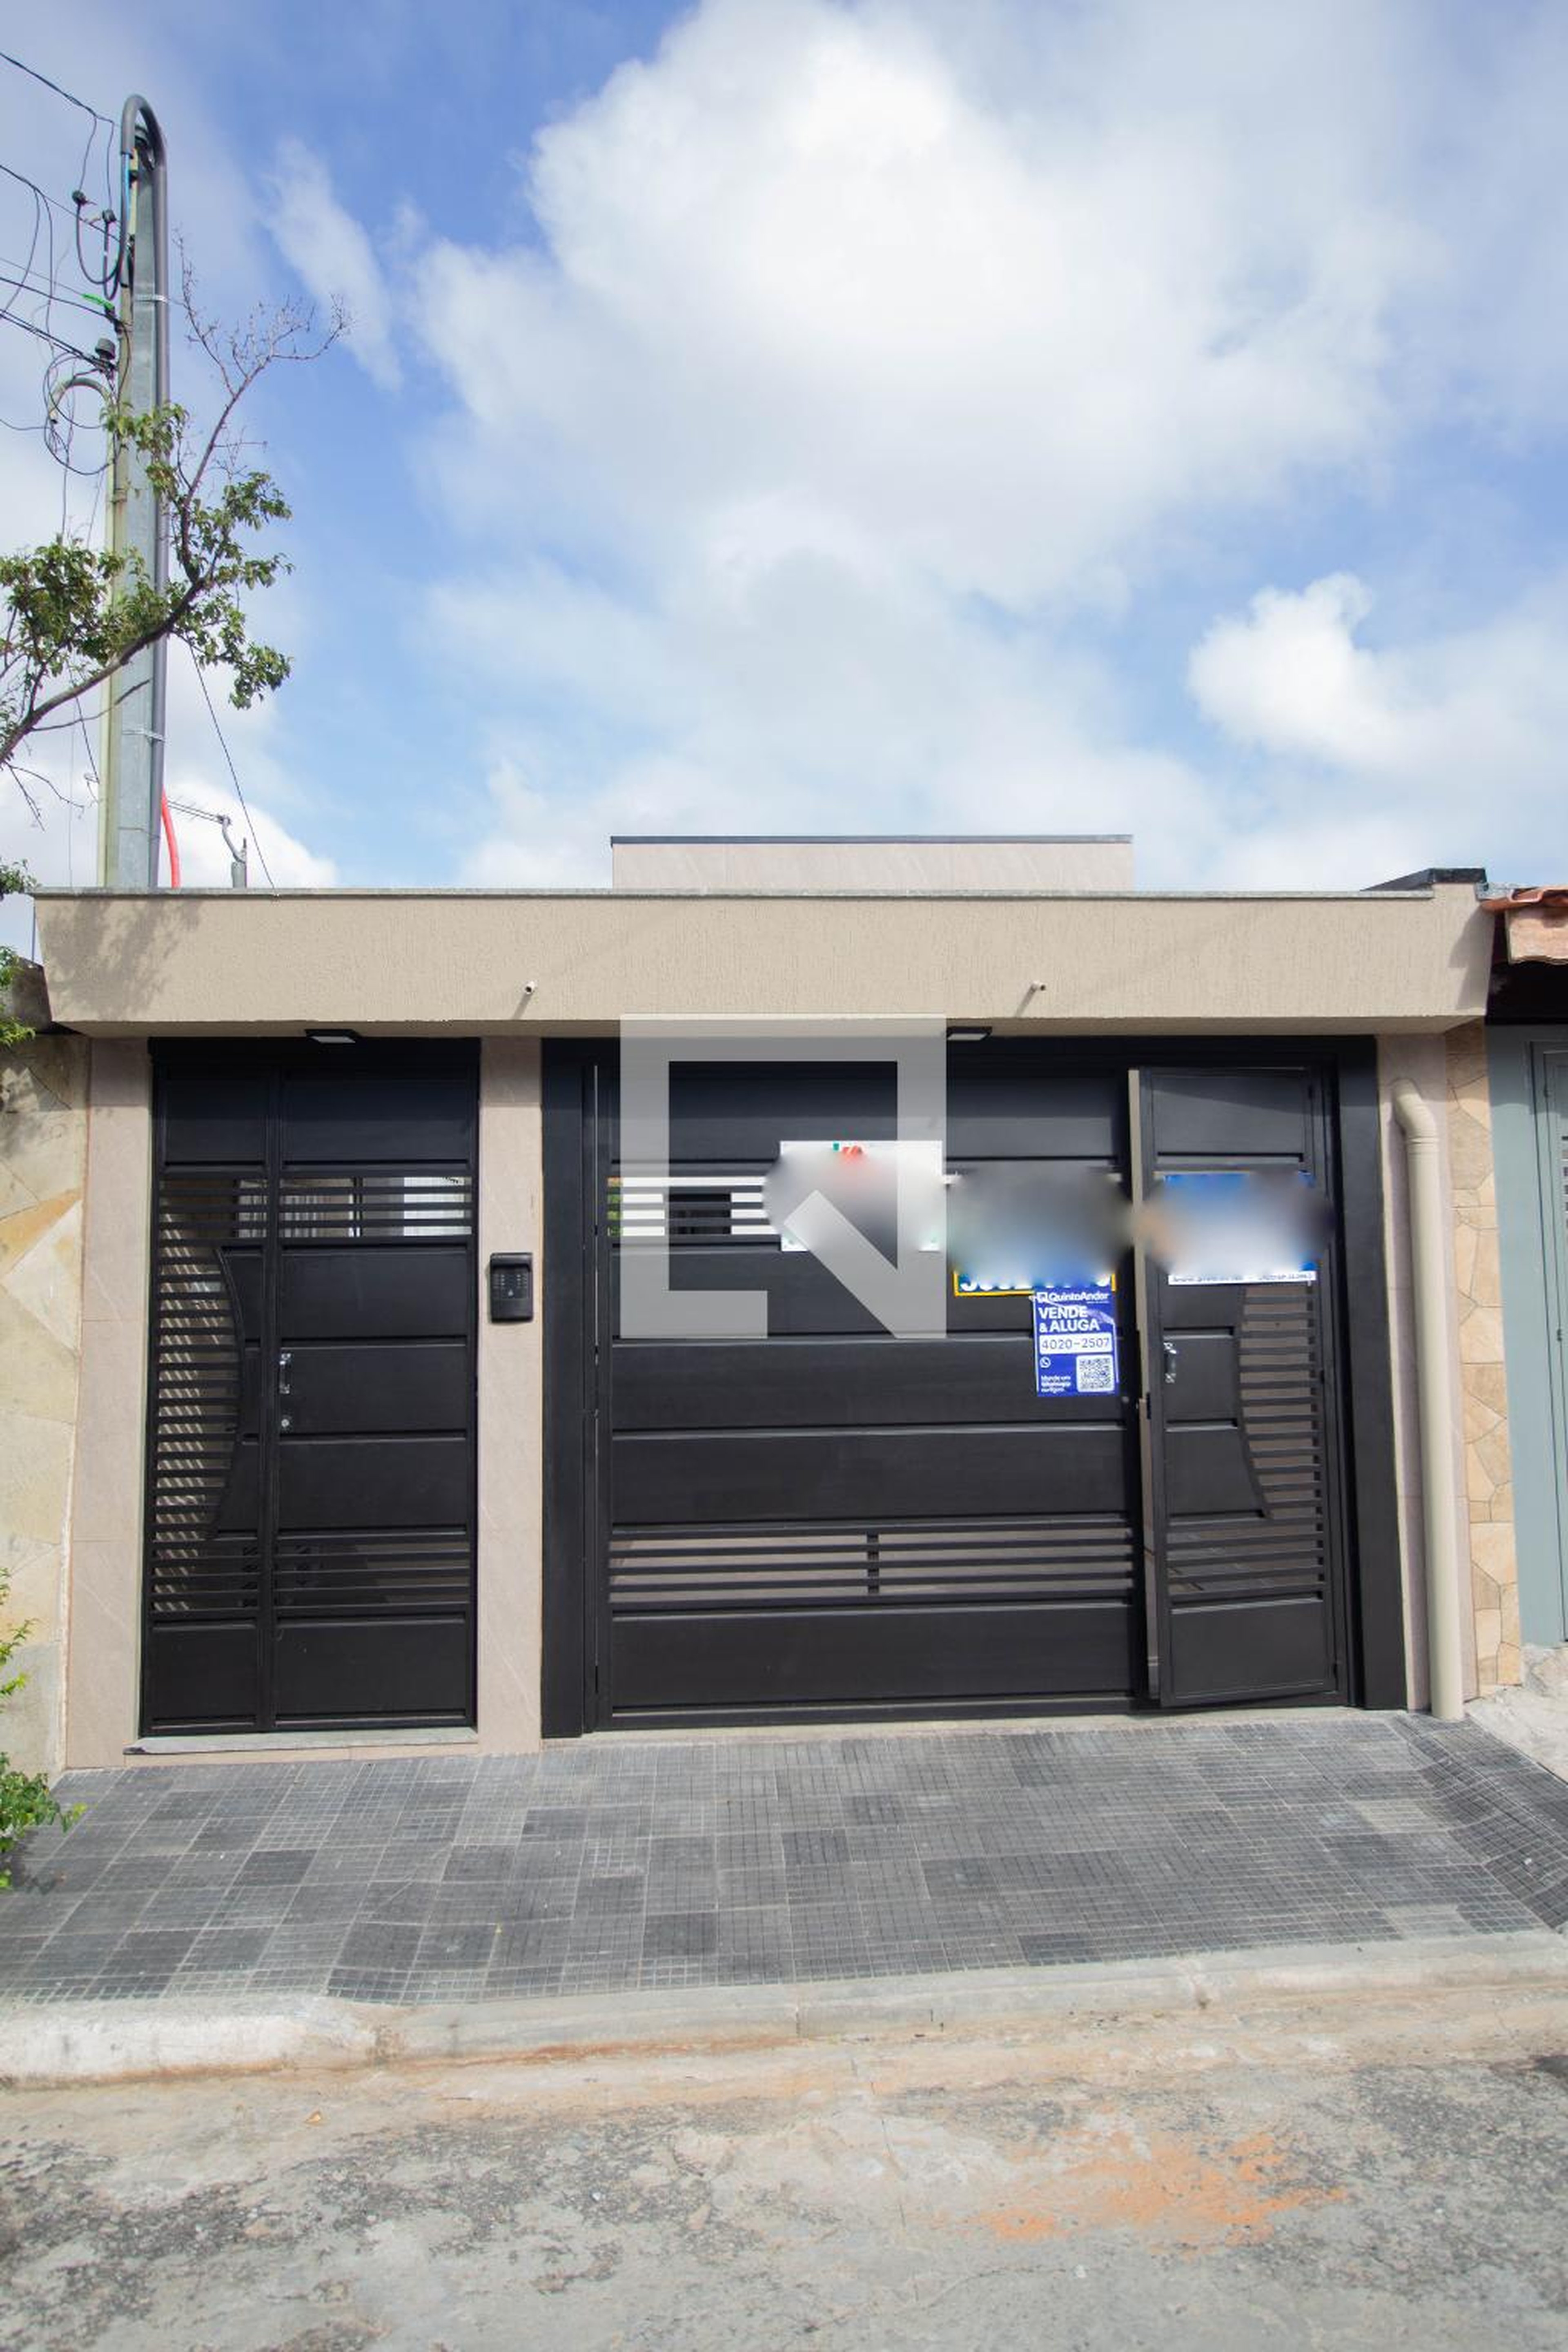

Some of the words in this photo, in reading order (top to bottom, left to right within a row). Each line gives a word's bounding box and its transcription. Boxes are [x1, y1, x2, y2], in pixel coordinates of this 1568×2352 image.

[1049, 1292, 1109, 1301] QuintoAndar
[1038, 1306, 1088, 1319] VENDE
[1039, 1323, 1047, 1333] &
[1050, 1319, 1100, 1332] ALUGA
[1042, 1338, 1109, 1349] 4020-2507
